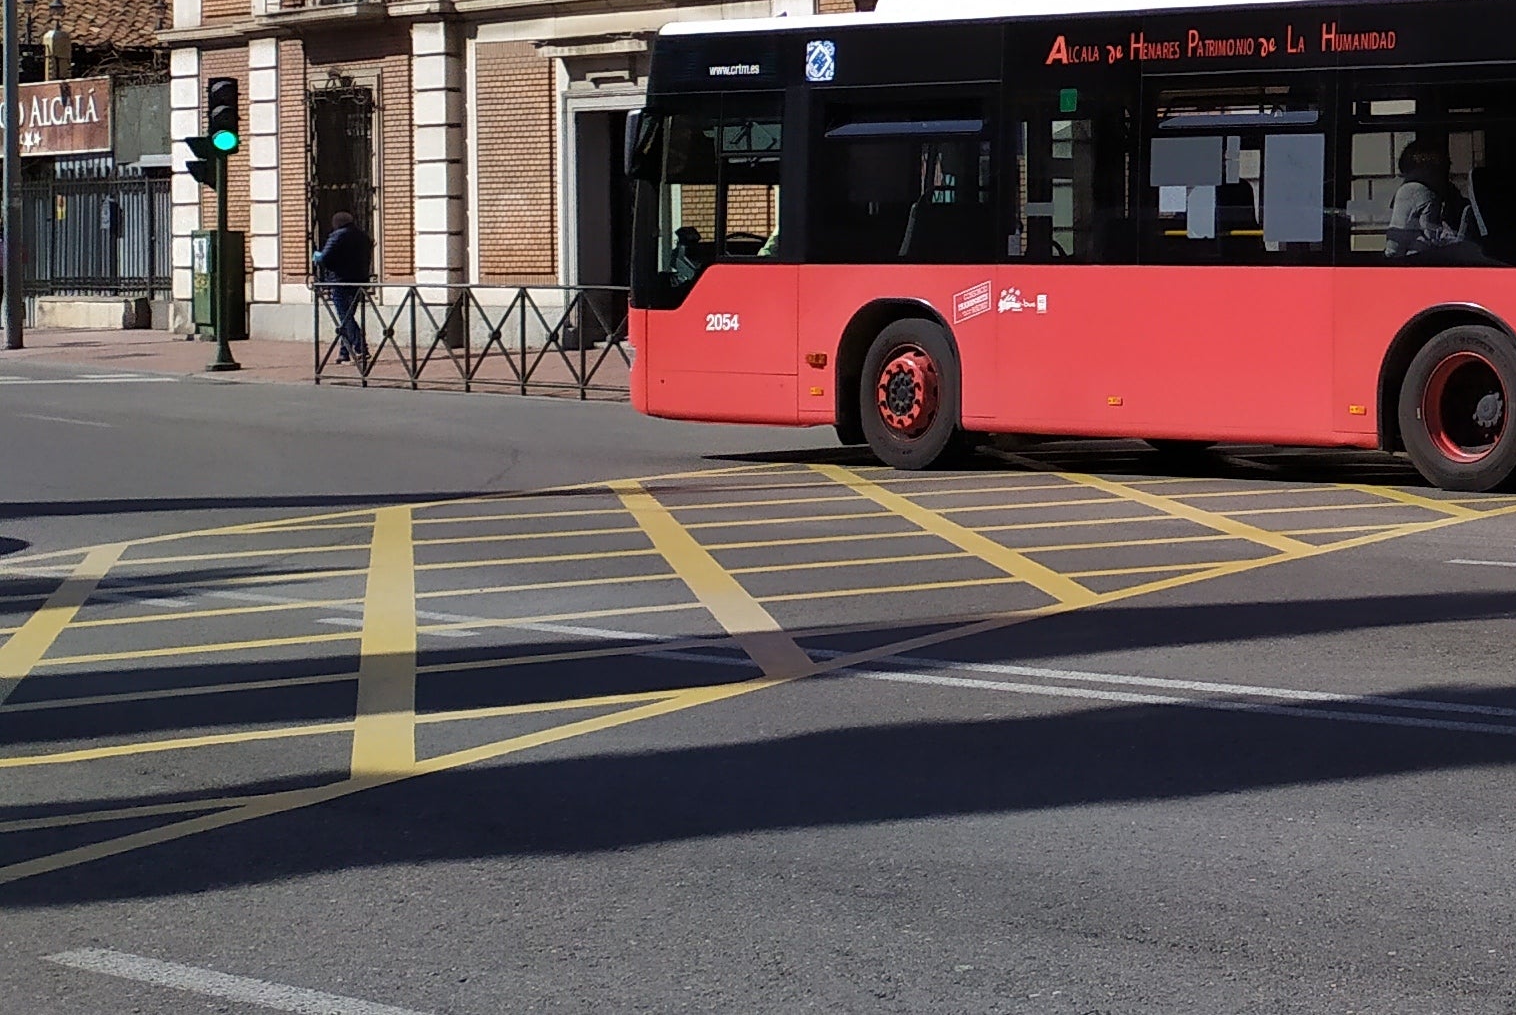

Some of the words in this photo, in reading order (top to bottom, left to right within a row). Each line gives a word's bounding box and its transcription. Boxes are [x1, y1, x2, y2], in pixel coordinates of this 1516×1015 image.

[1130, 32, 1180, 60] HENARES
[1188, 30, 1254, 57] PATRIMONIO
[1322, 23, 1396, 51] HUMANIDAD
[709, 63, 760, 76] www.crtm.es
[29, 88, 99, 127] ALCALÁ
[706, 314, 739, 331] 2054
